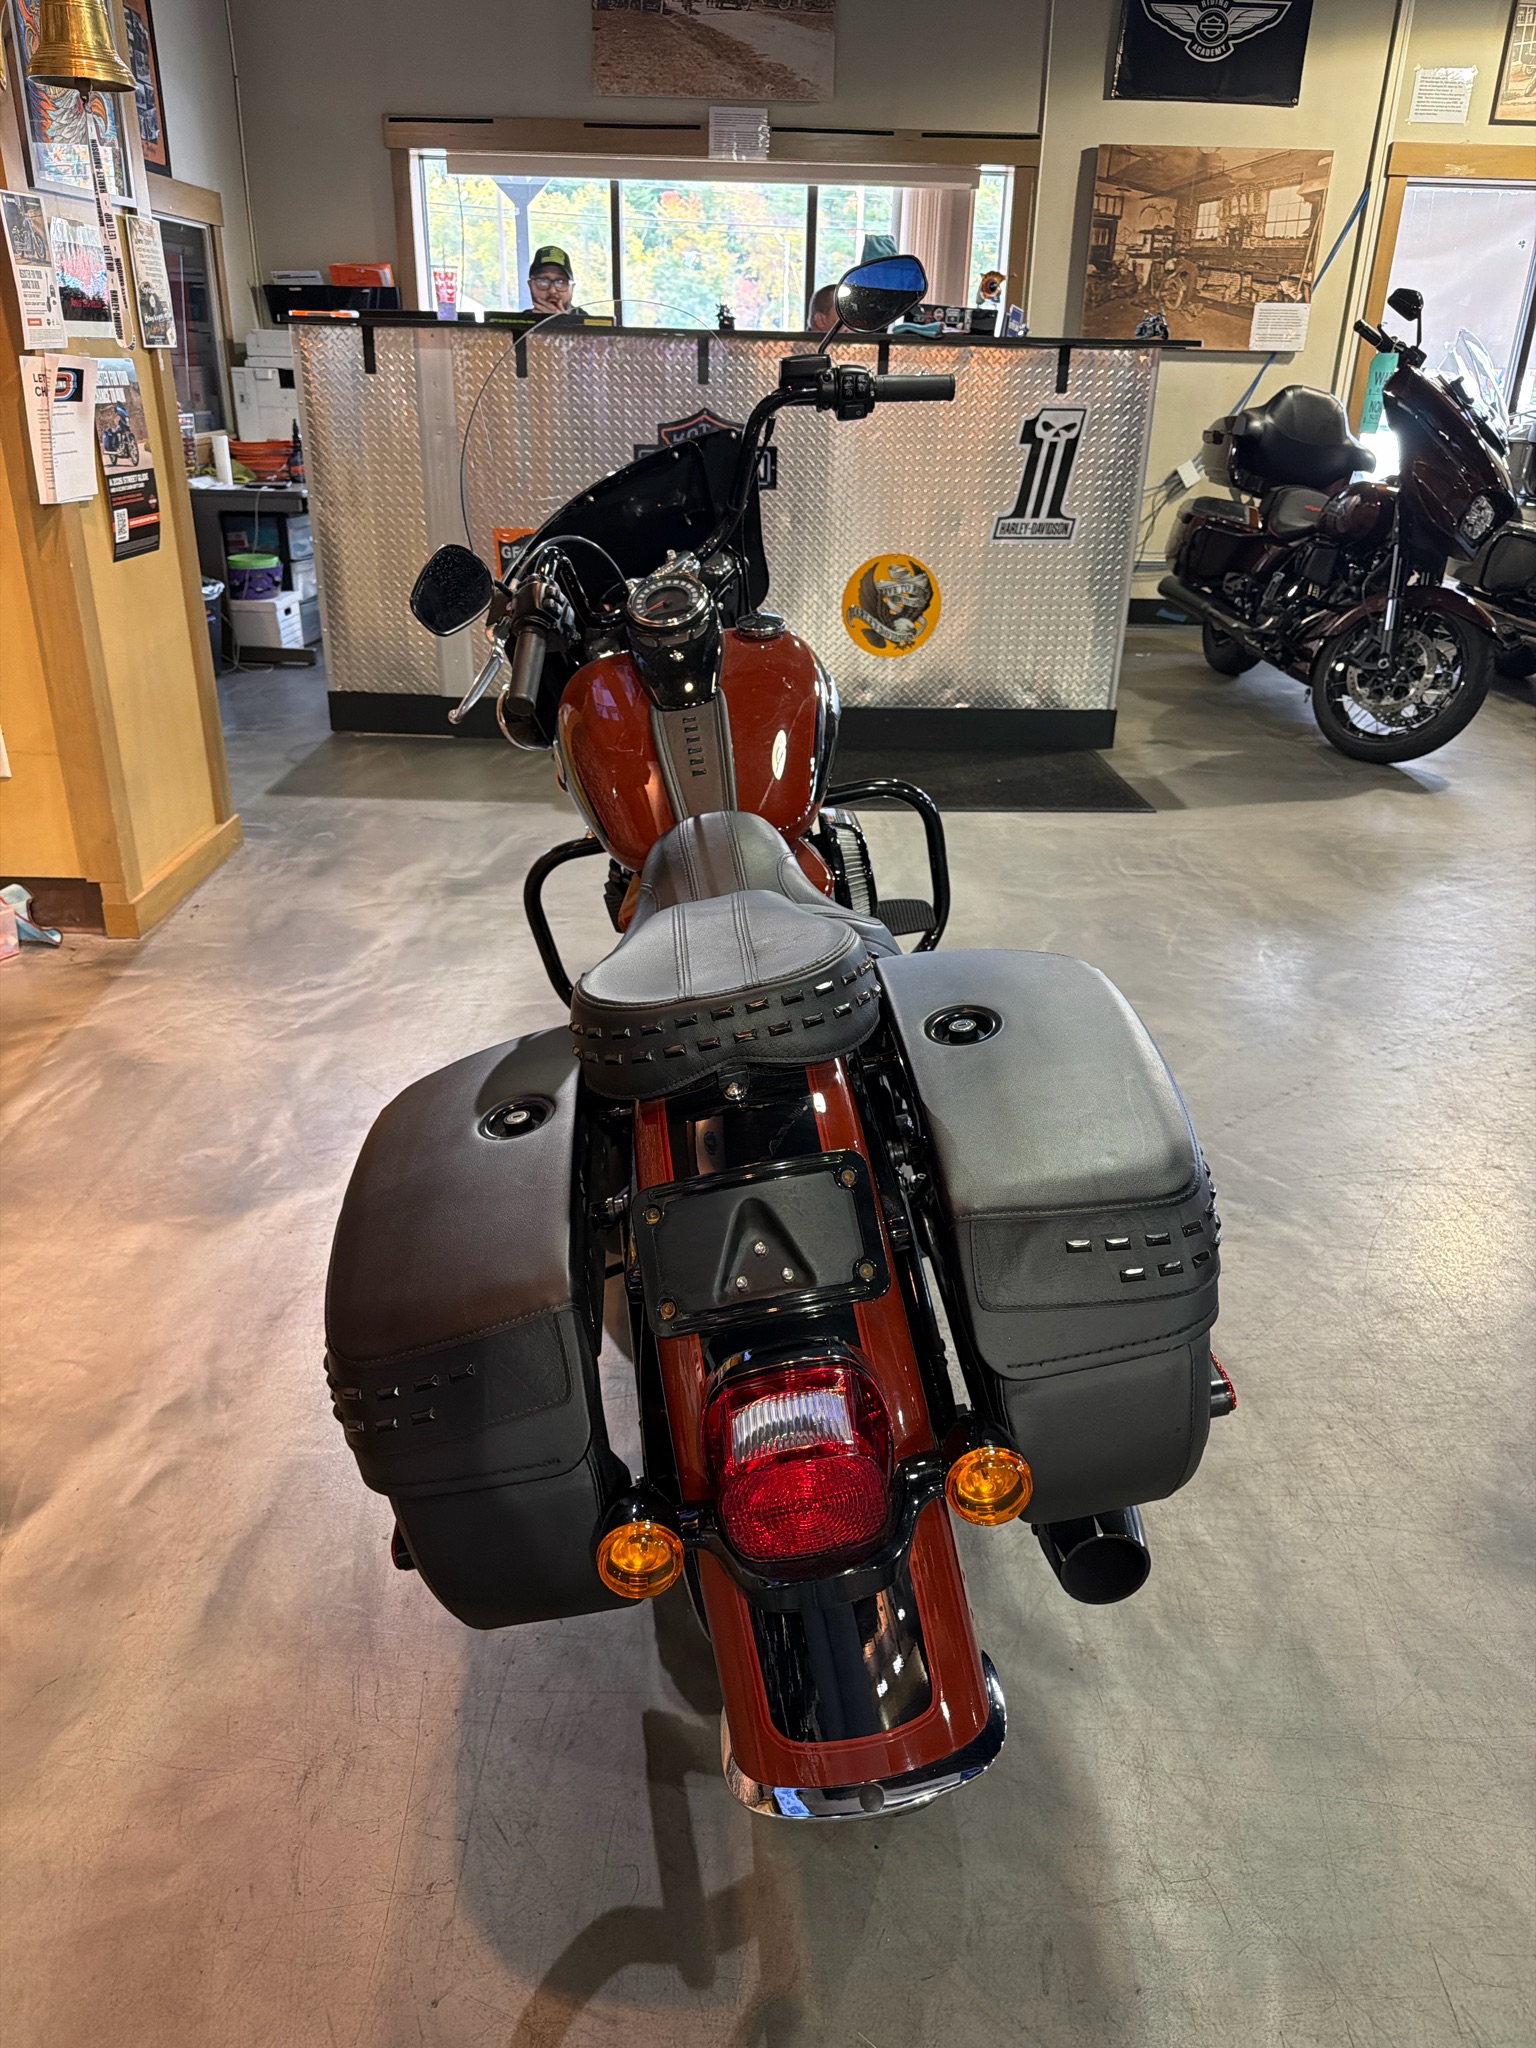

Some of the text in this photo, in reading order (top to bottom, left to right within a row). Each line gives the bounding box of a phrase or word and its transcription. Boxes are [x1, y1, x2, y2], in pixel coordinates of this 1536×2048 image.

[1201, 0, 1230, 9] RIDING
[1192, 44, 1228, 57] ACADEMY
[90, 139, 108, 194] HARLEY-DAVIDSON
[104, 213, 113, 223] RIP
[107, 230, 117, 240] LET
[103, 245, 113, 255] LET
[106, 262, 115, 272] RIP
[446, 271, 455, 303] KFC
[110, 289, 125, 341] HARLEY-DAVIDSON
[998, 522, 1071, 536] HARLEY-DAVIDSON
